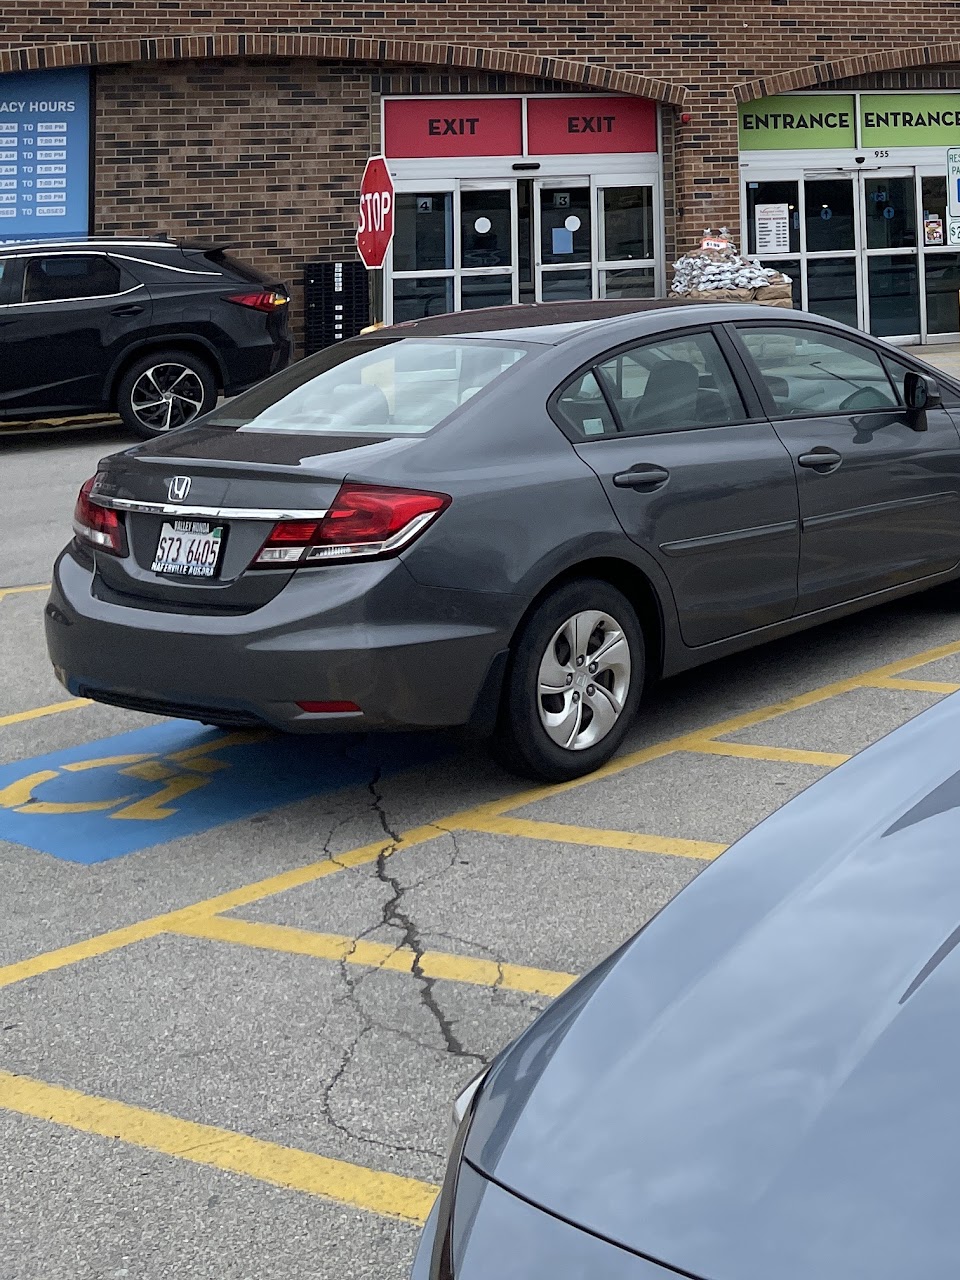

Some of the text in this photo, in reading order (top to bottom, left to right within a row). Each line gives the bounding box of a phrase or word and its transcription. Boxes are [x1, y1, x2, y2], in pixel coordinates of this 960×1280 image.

[30, 101, 75, 112] HOURS
[567, 116, 616, 133] EXIT
[742, 112, 850, 130] ENTRANCE
[23, 123, 34, 131] TO
[428, 117, 480, 136] EXIT
[22, 137, 34, 145] TO
[22, 151, 34, 159] TO
[874, 150, 889, 158] 955
[22, 180, 33, 188] TO
[21, 194, 33, 202] TO
[420, 201, 430, 211] 4
[21, 208, 33, 216] TO
[357, 191, 391, 233] STOP
[186, 538, 219, 566] 6405
